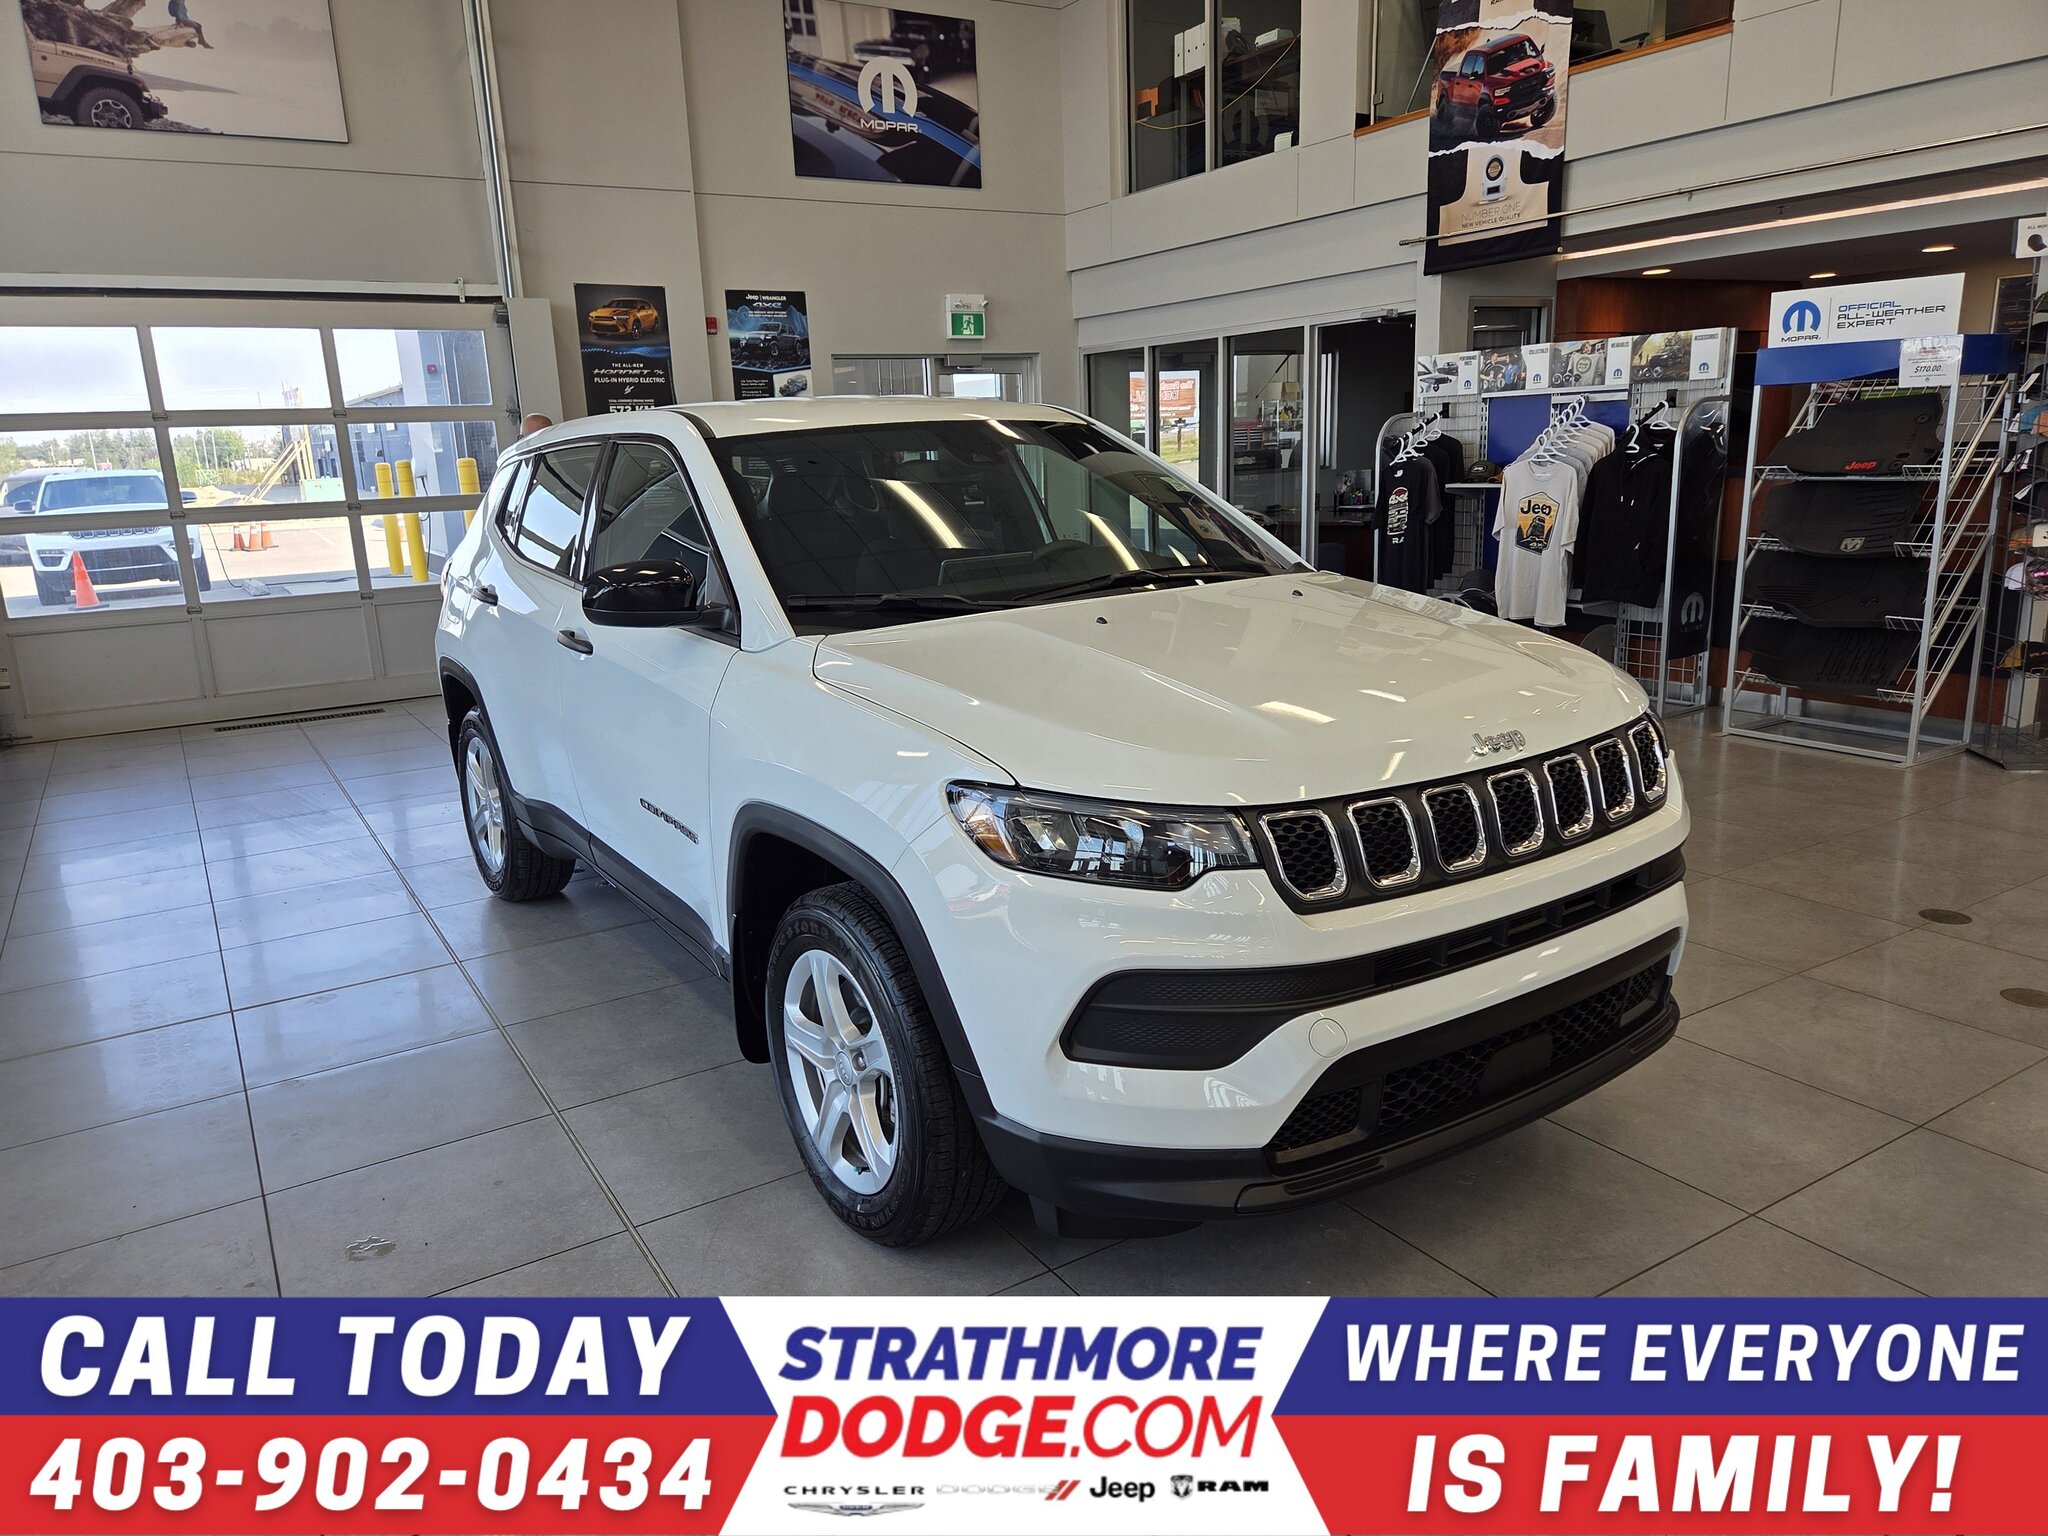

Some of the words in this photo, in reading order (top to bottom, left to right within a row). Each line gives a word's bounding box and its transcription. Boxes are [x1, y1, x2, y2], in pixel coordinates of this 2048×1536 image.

[860, 118, 918, 133] MOPAR
[1461, 206, 1500, 222] NUMBER
[1501, 201, 1521, 214] ONE
[1475, 217, 1498, 227] VEHICLE
[1499, 212, 1521, 222] QUALITY
[745, 293, 760, 301] Jeep
[1837, 305, 1946, 321] ALL-WEATHER
[1838, 300, 1902, 313] OFFICIAL
[1836, 317, 1896, 329] EXPERT
[1780, 334, 1819, 343] MOPAR
[1913, 364, 1942, 374] $170.00
[1844, 461, 1878, 471] Jeep
[1520, 499, 1553, 517] Jeep
[1471, 729, 1527, 758] Jeep
[639, 797, 699, 845] COMPASS
